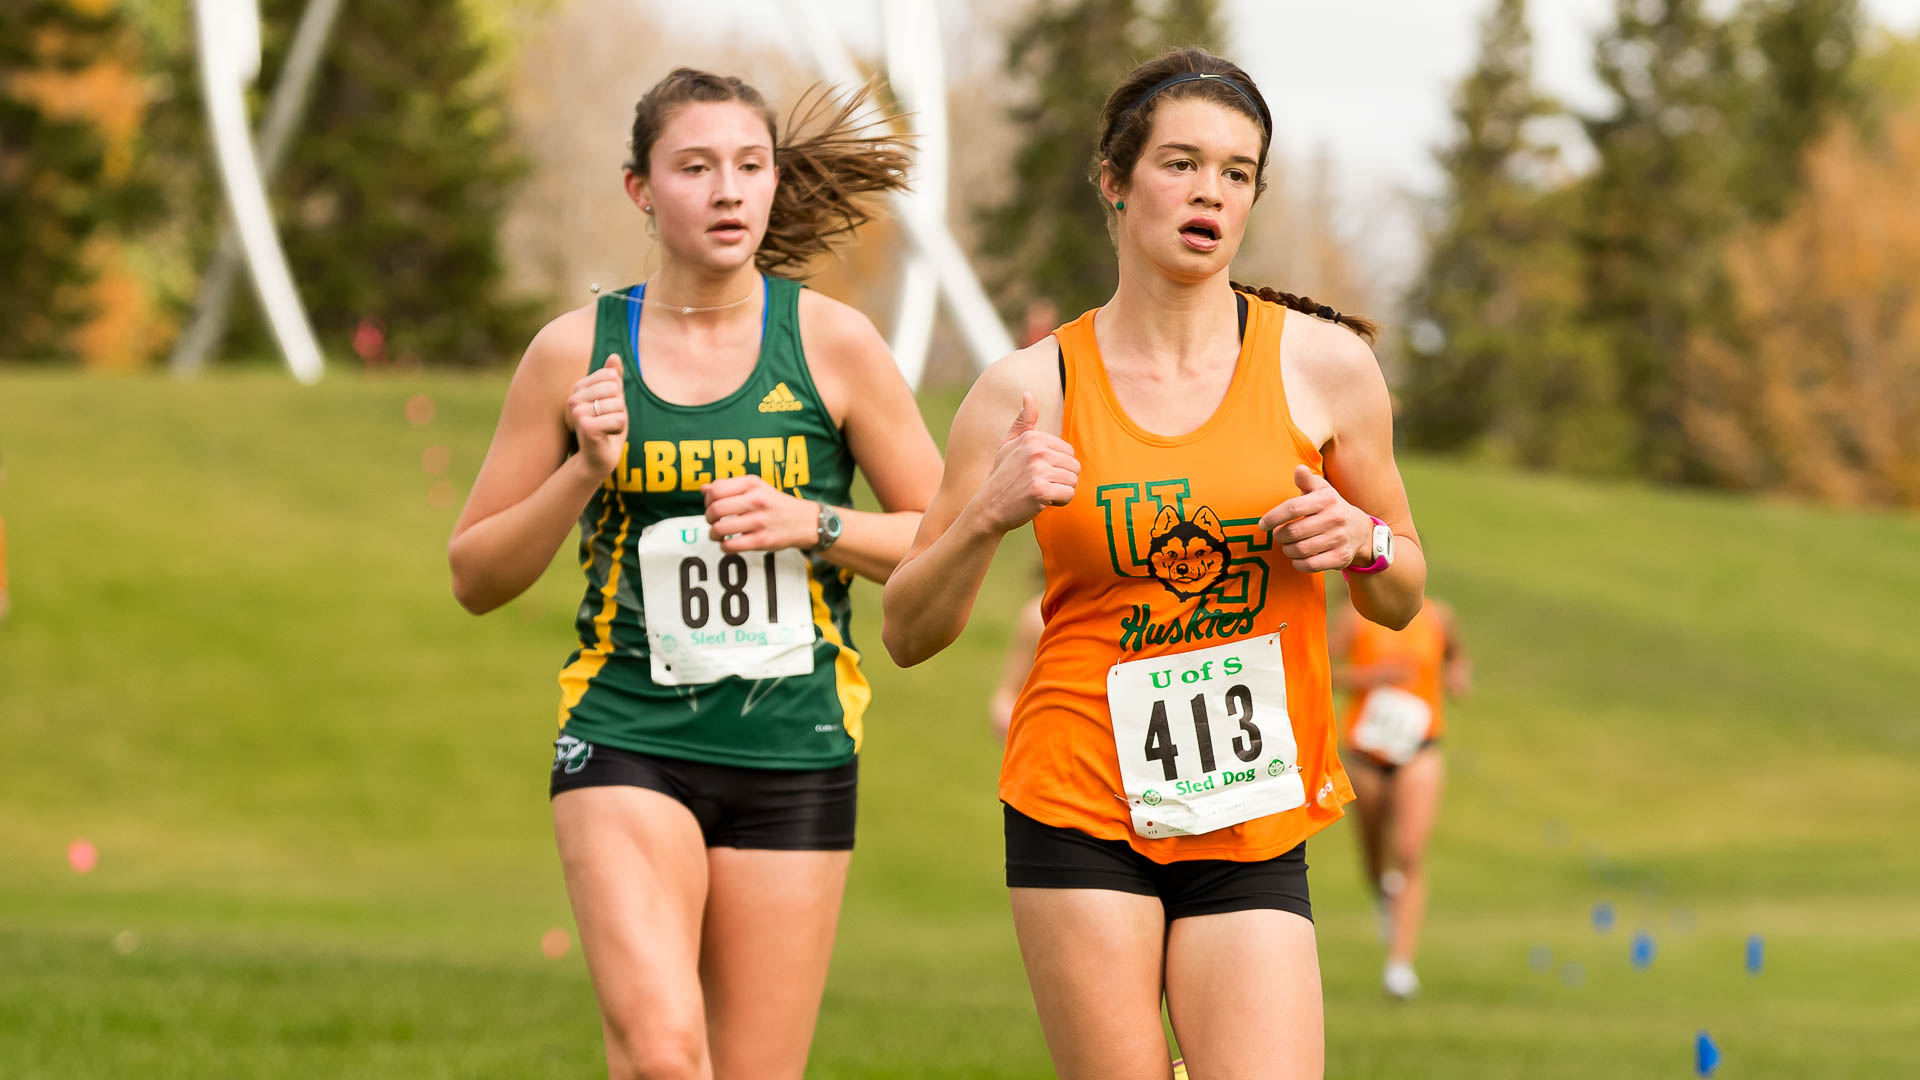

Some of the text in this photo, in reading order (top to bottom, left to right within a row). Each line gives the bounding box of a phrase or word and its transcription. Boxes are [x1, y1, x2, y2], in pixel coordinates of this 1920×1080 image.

[758, 401, 803, 413] adidas
[603, 435, 810, 492] LBERTA
[680, 528, 698, 545] U
[680, 552, 778, 629] 681
[690, 629, 768, 646] Sled Dog
[1119, 597, 1254, 652] Huskies
[1149, 656, 1243, 689] U of S
[1144, 684, 1263, 781] 413
[1175, 767, 1256, 796] Sled Dog
